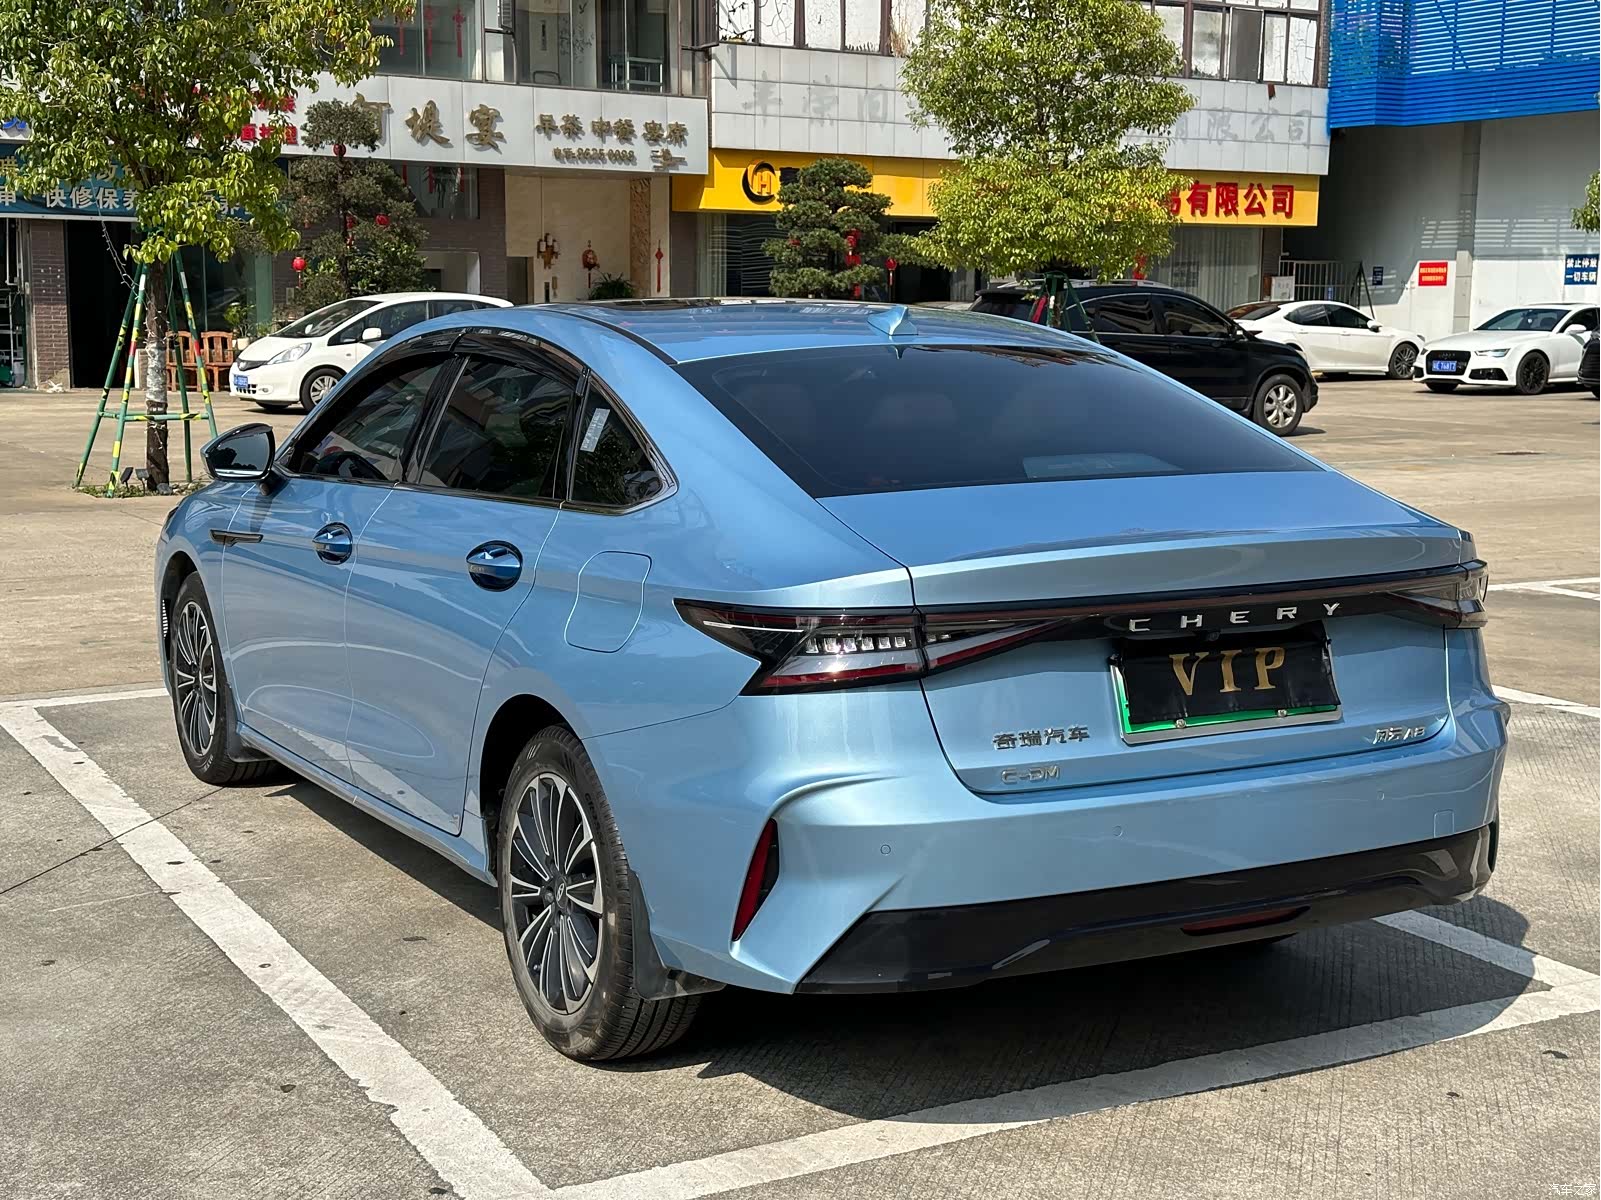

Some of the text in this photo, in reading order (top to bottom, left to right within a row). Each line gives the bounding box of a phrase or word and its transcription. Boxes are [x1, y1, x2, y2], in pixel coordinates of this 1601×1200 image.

[1566, 257, 1598, 269] 禁止停放
[1565, 271, 1597, 283] 一切车辆
[1128, 602, 1341, 632] CHERY
[1168, 647, 1286, 696] VIP
[992, 725, 1091, 751] 奇瑞汽车
[1001, 765, 1061, 784] C-DM
